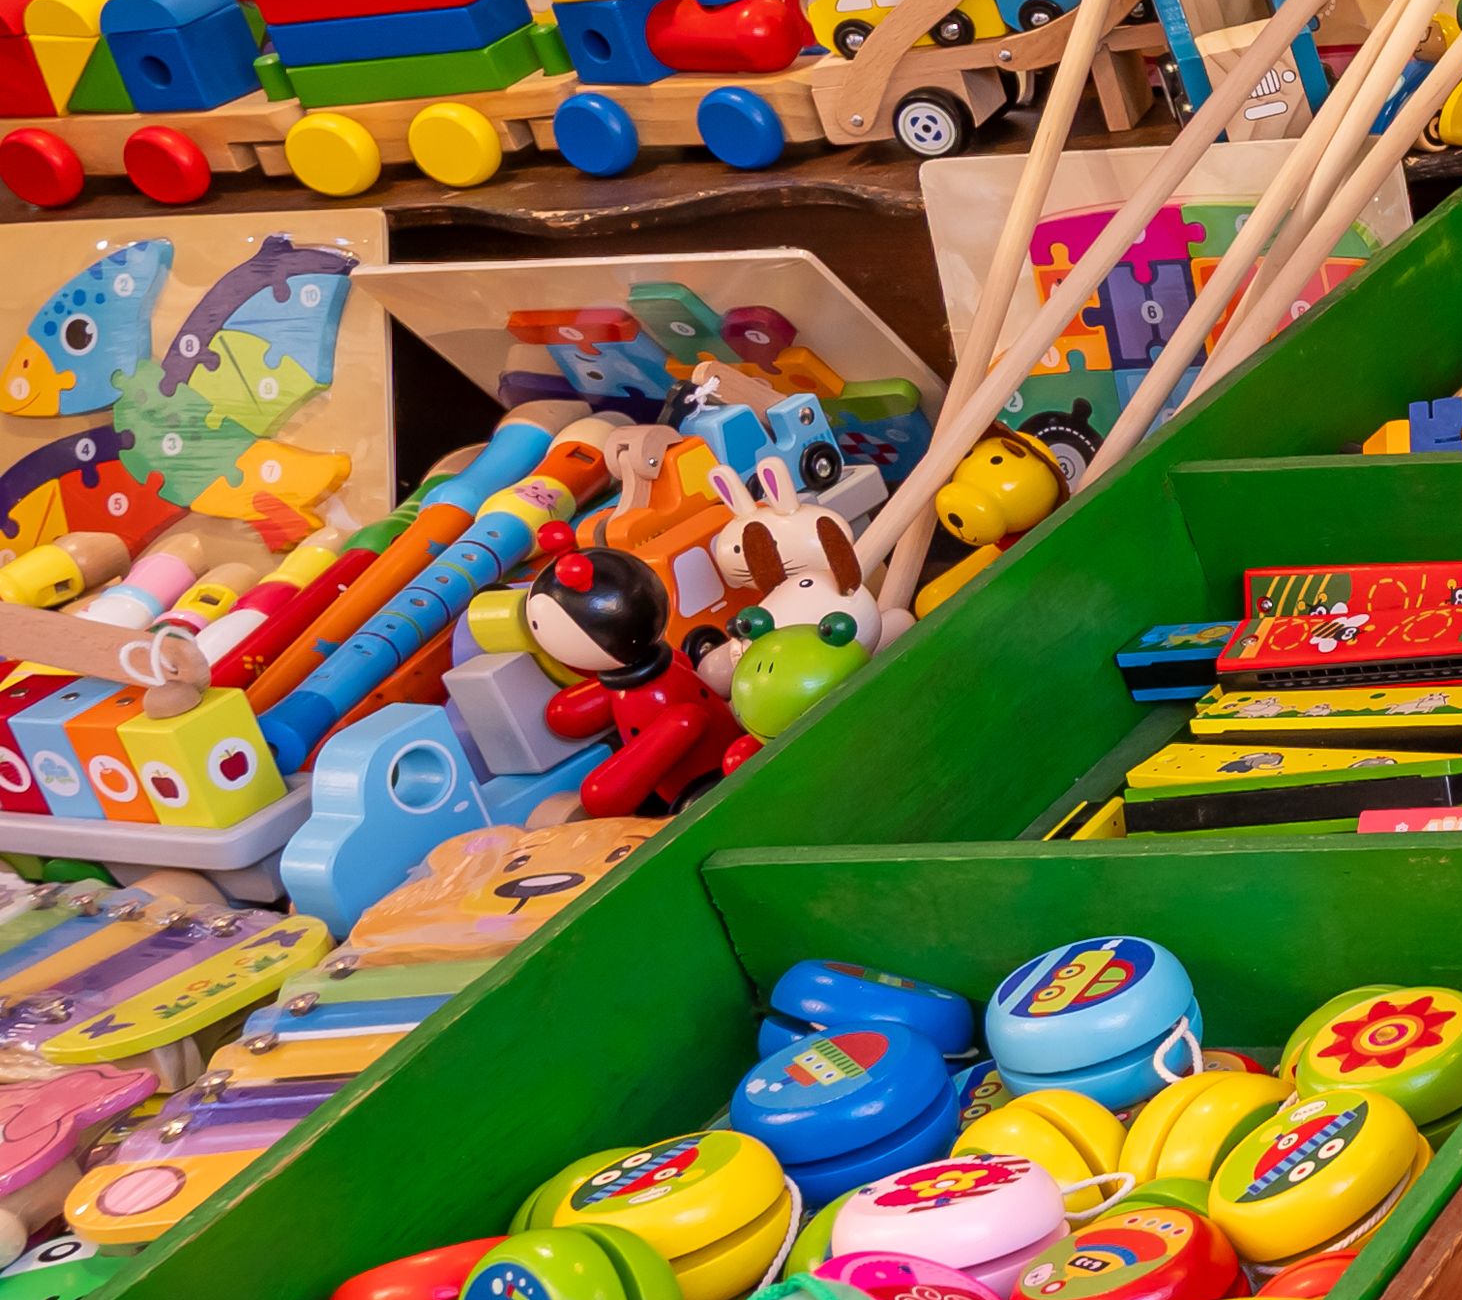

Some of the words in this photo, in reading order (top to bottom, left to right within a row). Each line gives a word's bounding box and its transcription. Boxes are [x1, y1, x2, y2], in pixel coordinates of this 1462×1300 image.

[1147, 305, 1158, 319] 6
[185, 338, 195, 352] 8
[1009, 395, 1019, 408] 2
[81, 443, 91, 457] 4
[166, 437, 176, 451] 3
[113, 497, 123, 511] 5
